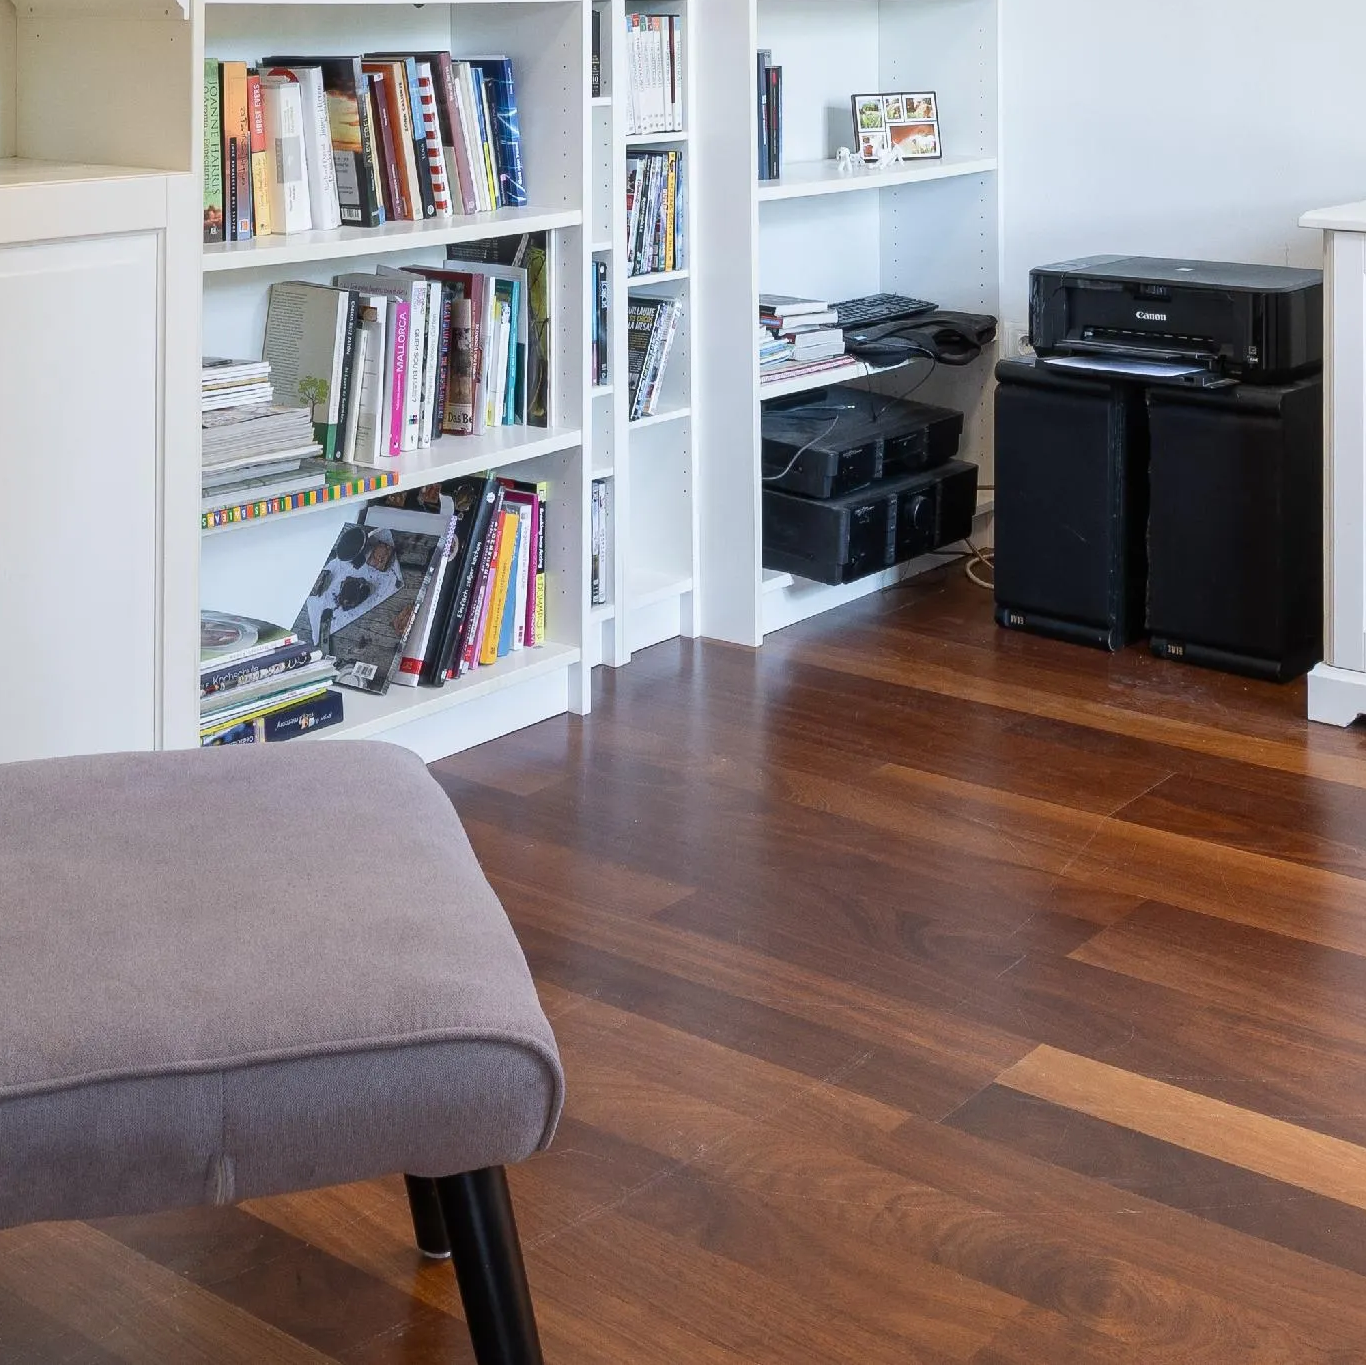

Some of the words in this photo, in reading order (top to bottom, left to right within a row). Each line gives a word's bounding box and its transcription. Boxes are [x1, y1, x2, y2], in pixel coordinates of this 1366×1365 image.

[209, 81, 219, 137] JOANNE
[210, 144, 221, 195] HARRIS
[1135, 311, 1167, 321] Canon
[395, 312, 407, 372] MALLORCA
[448, 412, 462, 423] Das
[276, 717, 299, 729] memory
